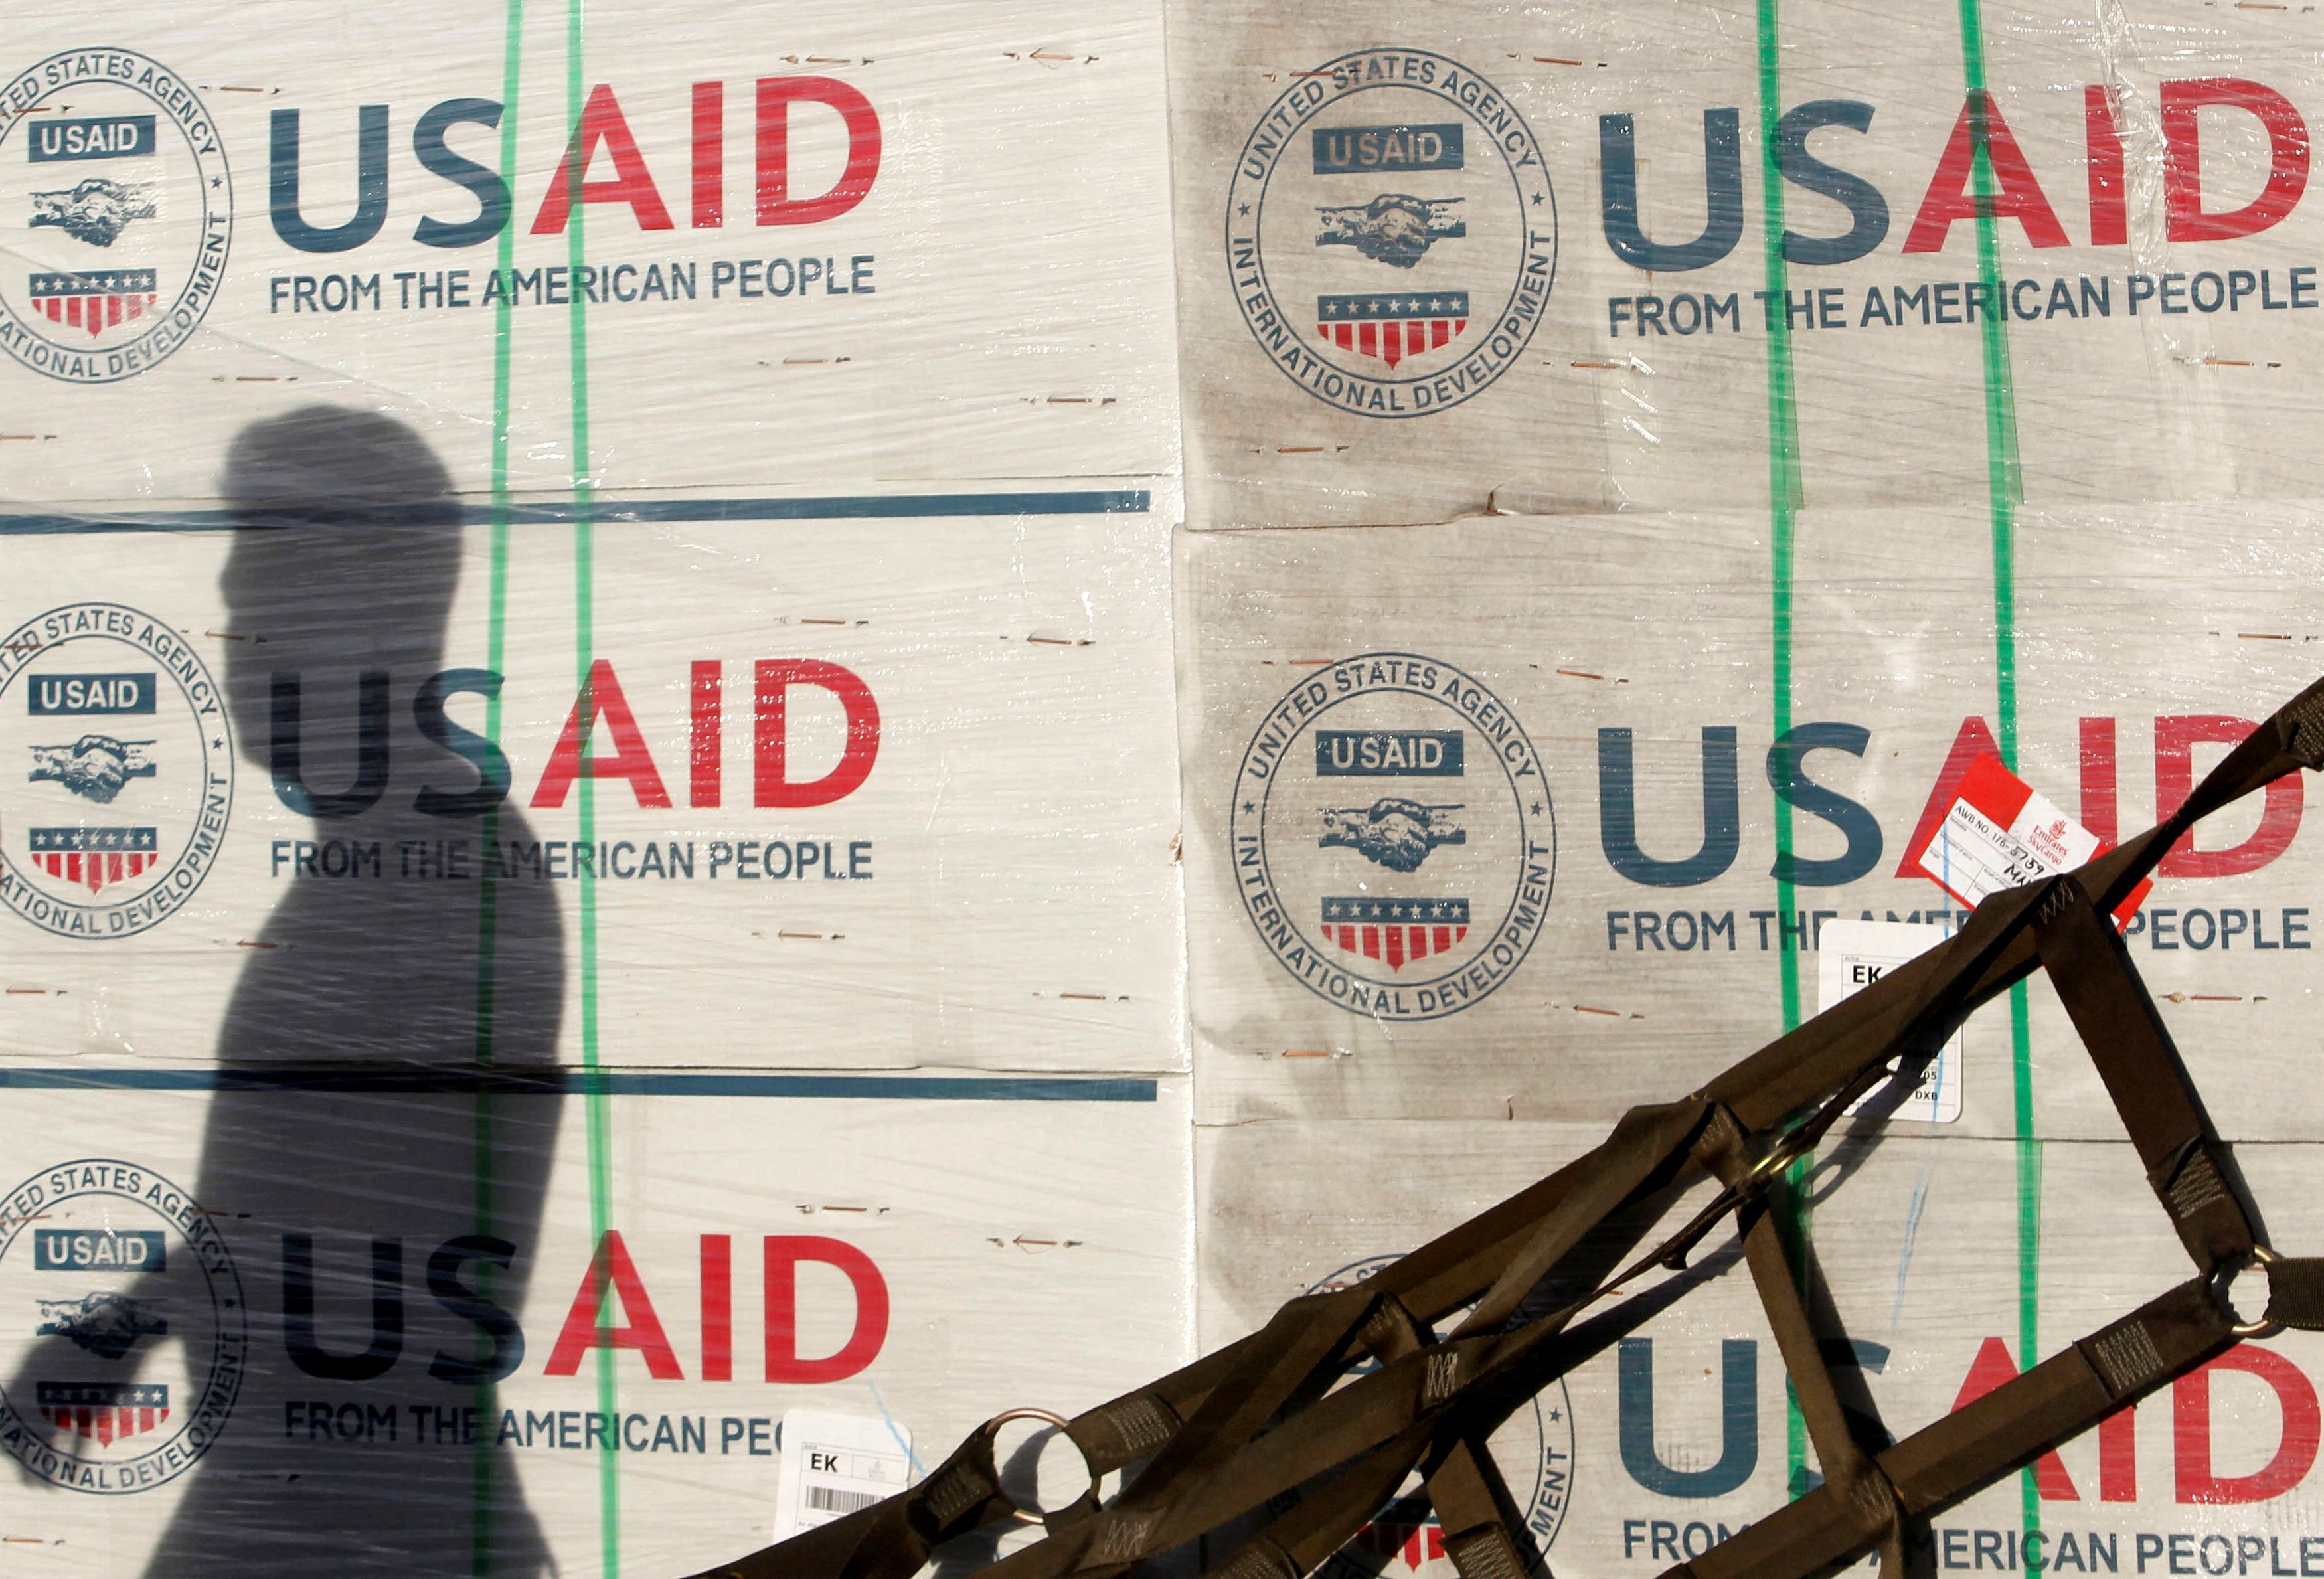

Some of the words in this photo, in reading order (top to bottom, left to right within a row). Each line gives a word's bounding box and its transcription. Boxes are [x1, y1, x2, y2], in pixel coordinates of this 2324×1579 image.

[0, 76, 39, 130] TED
[46, 54, 135, 86] STATES
[138, 67, 217, 155] AGENCY
[1243, 80, 1325, 181] UNITED
[1333, 56, 1436, 90] STATES
[1441, 70, 1539, 169] AGENCY
[41, 122, 139, 155] USAID
[270, 74, 883, 253] USAID
[1329, 132, 1444, 166] USAID
[1599, 77, 2311, 272] USAID
[0, 311, 101, 377] ATIONAL
[109, 211, 226, 376] DEVELOPMENT
[270, 273, 380, 313] FROM
[394, 270, 470, 309] THE
[481, 262, 697, 305] AMERICAN
[712, 254, 876, 299] PEOPLE
[1608, 292, 1741, 337] FROM
[1754, 288, 1847, 331] THE
[1859, 276, 2111, 327] AMERICAN
[2127, 266, 2319, 317] PEOPLE
[1232, 237, 1405, 412] INTERNATIONAL
[1413, 230, 1550, 409] DEVELOPMENT
[0, 630, 39, 683] TED
[45, 610, 135, 639] STATES
[139, 625, 218, 716] AGENCY
[41, 679, 139, 710] USAID
[1248, 681, 1328, 780] UNITED
[1335, 660, 1438, 693] STATES
[1442, 677, 1536, 780] AGENCY
[270, 659, 882, 819] USAID
[1331, 738, 1444, 769] USAID
[1955, 805, 1976, 823] AWB
[1975, 820, 1992, 837] NO.
[2027, 835, 2062, 866] SkyCargo
[2033, 825, 2070, 857] Emirates
[109, 772, 227, 932] DEVELOPMENT
[271, 840, 380, 878] FROM
[394, 840, 470, 880] THE
[480, 841, 694, 880] AMERICAN
[710, 841, 873, 880] PEOPLE
[1238, 835, 1410, 1014] INTERNATIONAL
[1418, 840, 1549, 1013] DEVELOPMENT
[1607, 910, 1736, 950] FROM
[2125, 908, 2311, 950] PEOPLE
[1853, 965, 1883, 984] EK
[1915, 1090, 1938, 1100] DXB
[0, 1185, 43, 1244] ITED
[50, 1166, 141, 1195] STATES
[145, 1183, 230, 1274] AGENCY
[46, 1235, 149, 1266] USAID
[281, 1230, 890, 1384] USAID
[120, 1332, 241, 1488] DEVELOPMENT
[284, 1400, 397, 1444] FROM
[408, 1404, 483, 1446] THE
[497, 1408, 706, 1454] AMERICAN
[721, 1416, 782, 1457] PE
[811, 1452, 839, 1473] EK
[1870, 1529, 2119, 1573] ERICAN
[2135, 1533, 2324, 1578] PEOPLE
